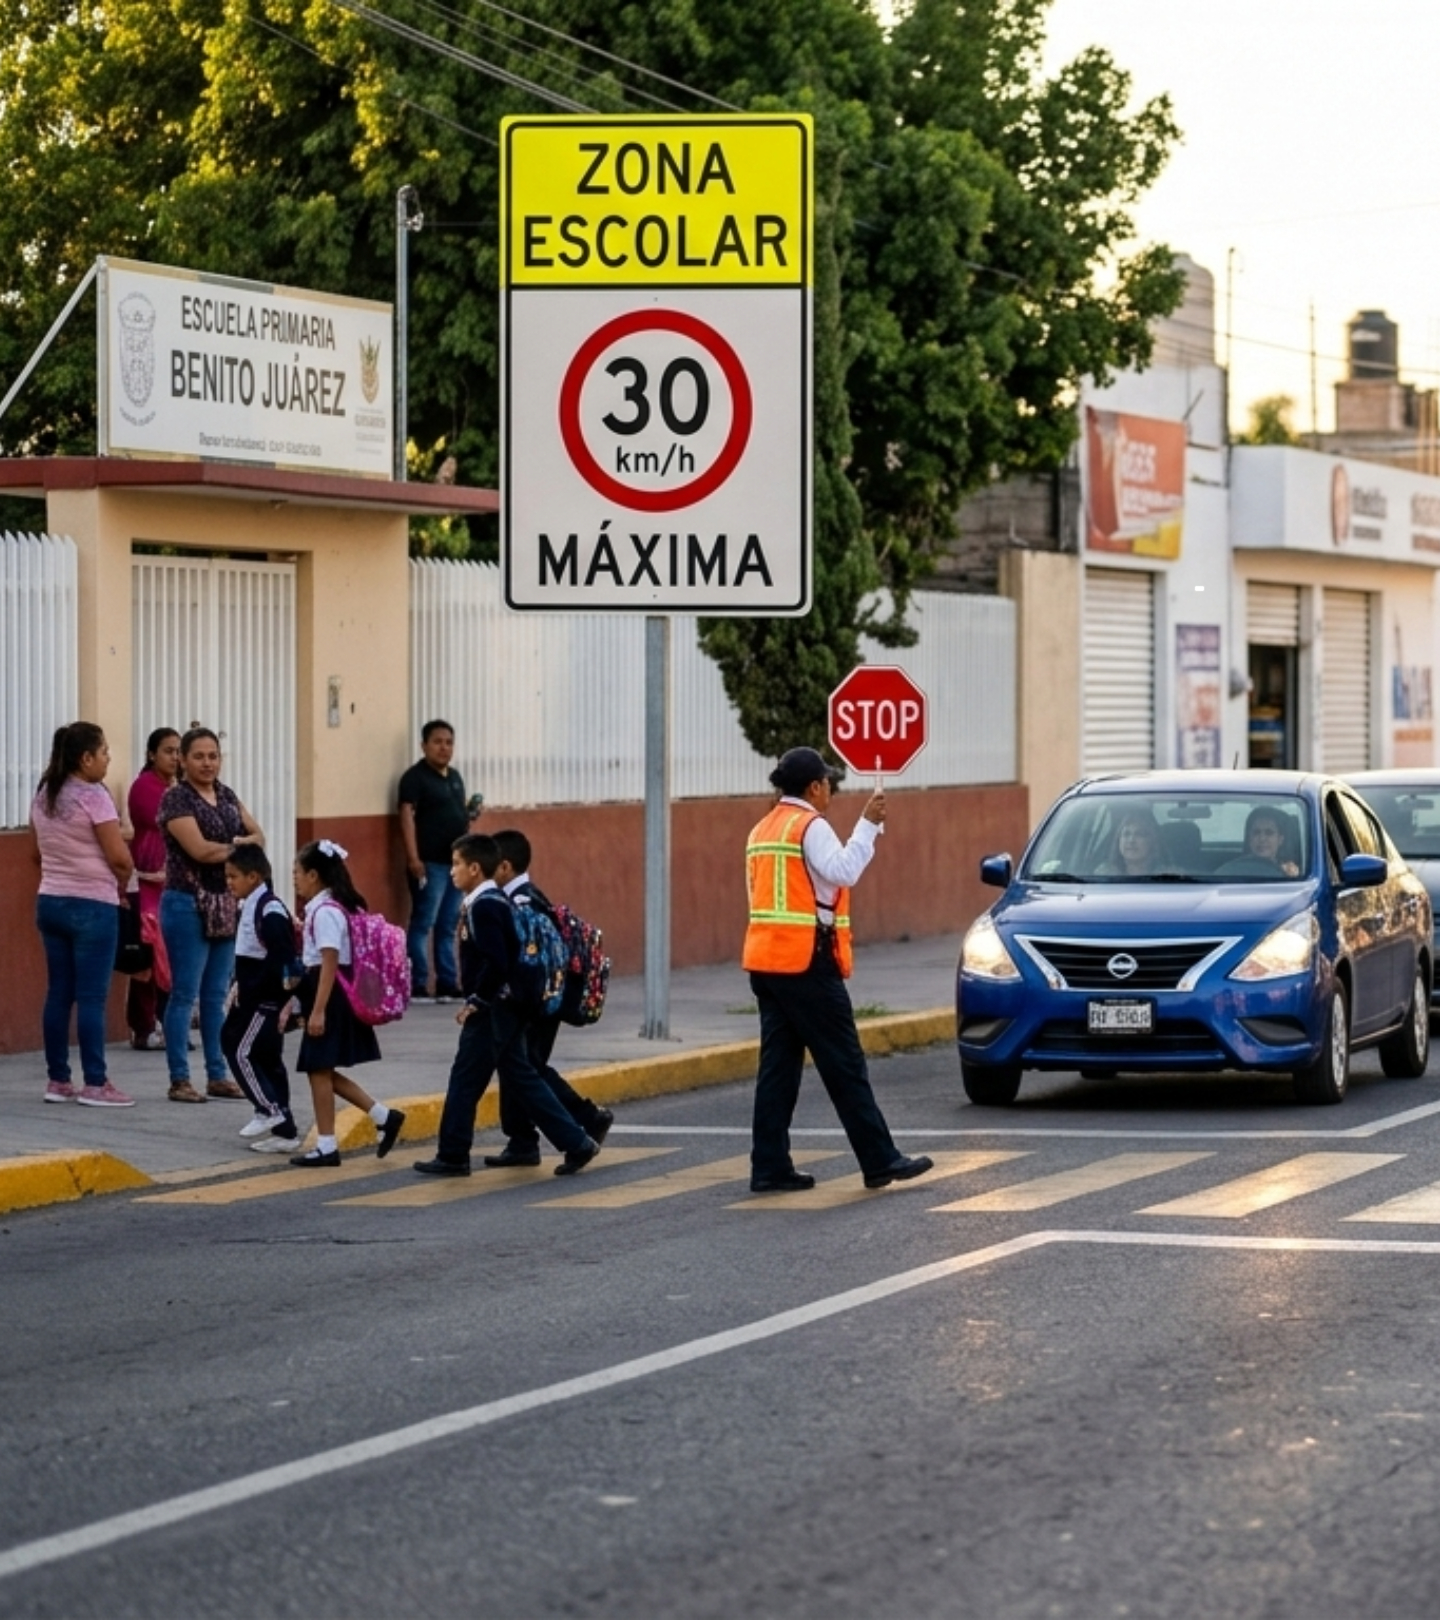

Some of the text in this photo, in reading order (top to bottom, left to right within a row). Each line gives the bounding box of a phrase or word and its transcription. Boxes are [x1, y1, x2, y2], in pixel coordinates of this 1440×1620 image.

[576, 142, 736, 195] ZONA
[523, 214, 788, 268] ESCOLAR
[181, 294, 336, 351] ESCUELA PRIMARIA
[171, 349, 346, 417] BENITO JUÁREZ
[601, 356, 711, 436] 30
[615, 443, 695, 477] km/h
[537, 520, 774, 587] MÁXIMA
[836, 700, 920, 740] STOP
